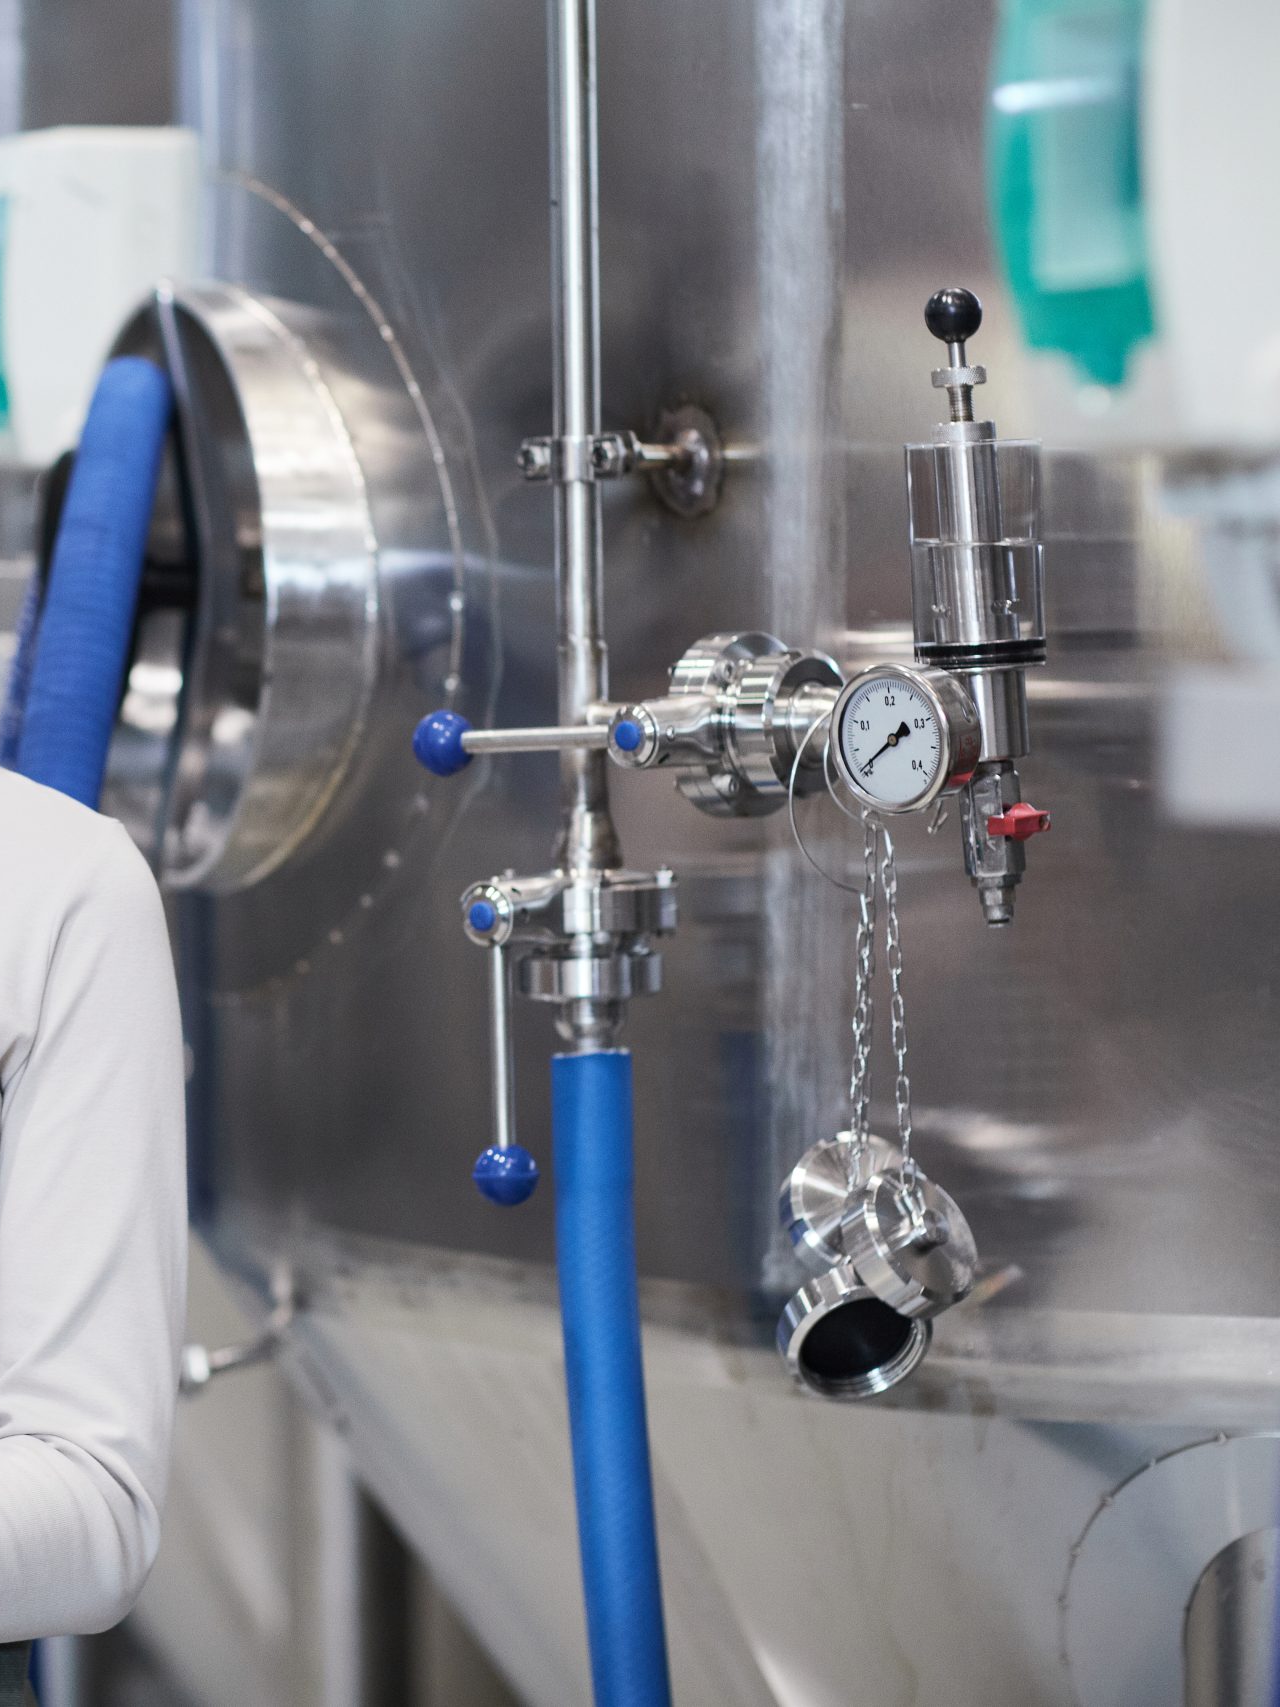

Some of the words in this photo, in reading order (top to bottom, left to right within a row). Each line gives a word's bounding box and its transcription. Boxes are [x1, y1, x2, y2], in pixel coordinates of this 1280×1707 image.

[885, 695, 895, 706] 0,2
[860, 720, 870, 731] 0,1
[914, 718, 925, 729] 0,3
[911, 760, 922, 771] 0,4
